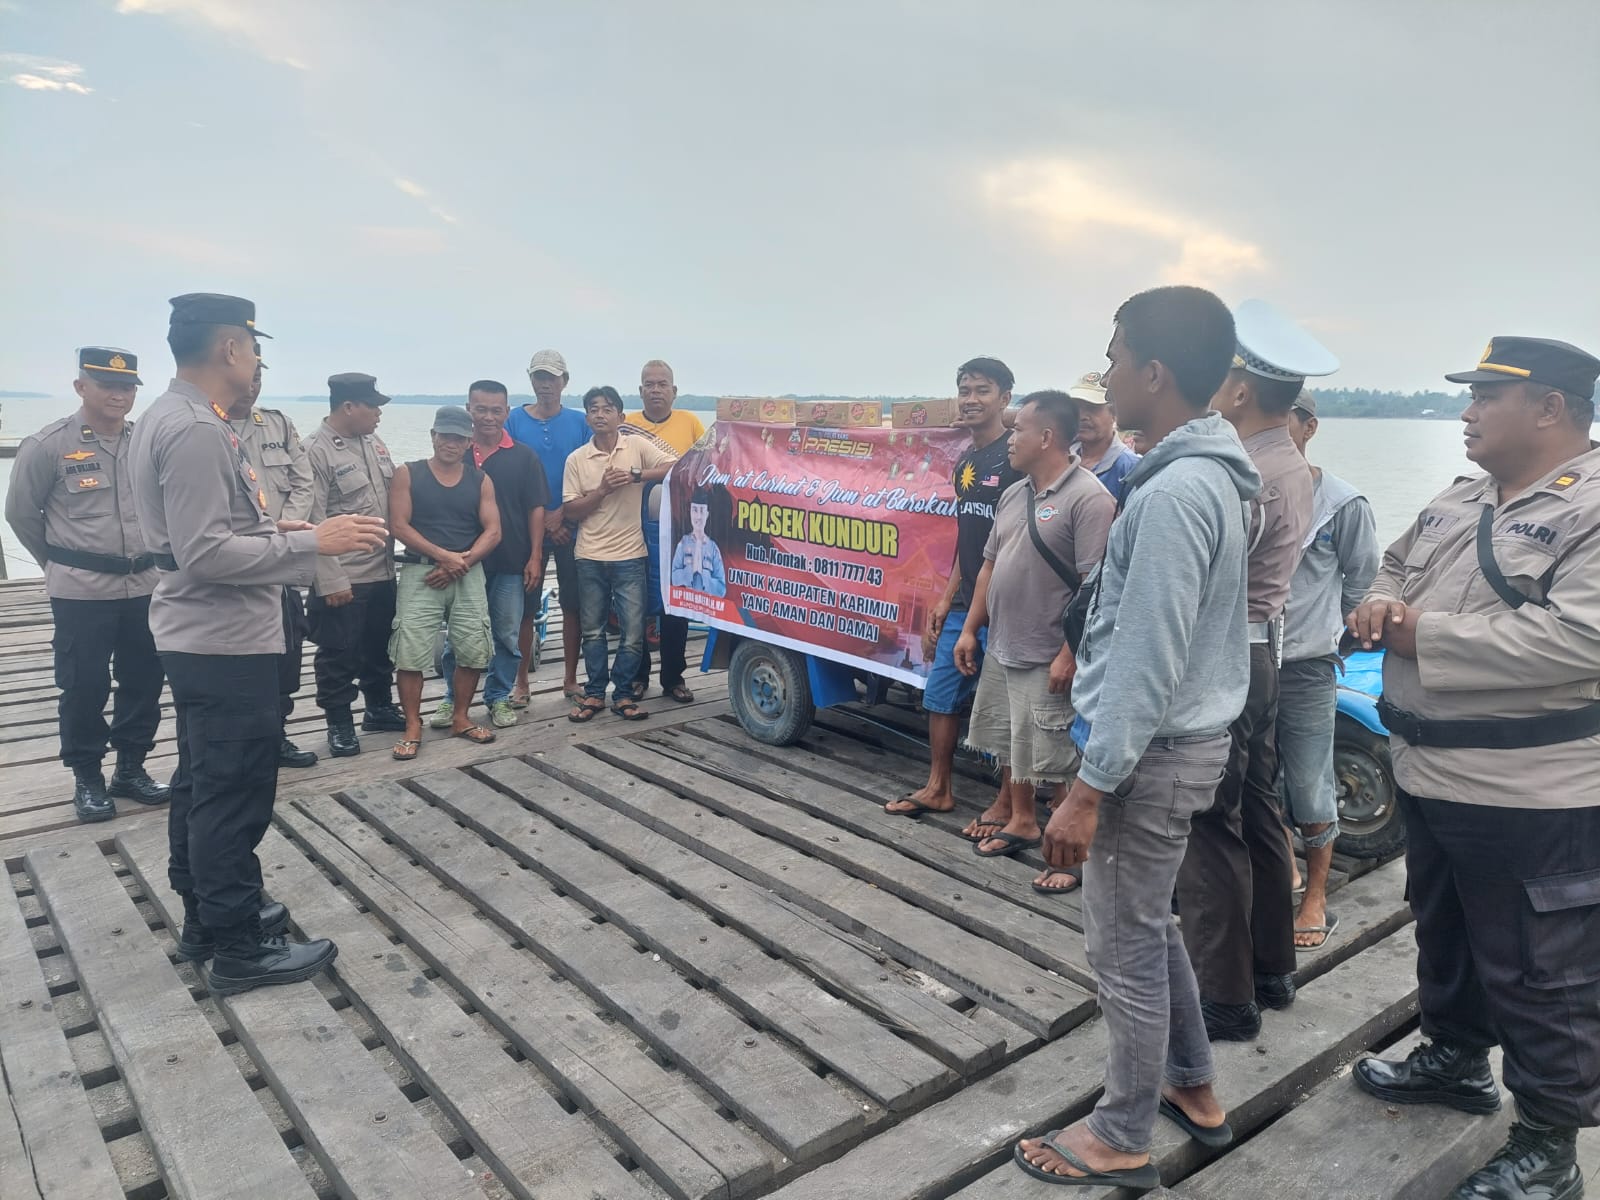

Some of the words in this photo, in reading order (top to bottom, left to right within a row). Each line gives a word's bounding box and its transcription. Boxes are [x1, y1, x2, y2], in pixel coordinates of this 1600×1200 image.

[804, 437, 874, 458] PRESISI
[751, 470, 808, 496] Curhat
[805, 479, 822, 497] &
[737, 500, 807, 539] POLSEK
[807, 510, 899, 558] KUNDUR
[1506, 522, 1557, 545] POLRI
[745, 543, 769, 565] Hub.
[768, 548, 807, 571] Kontak
[813, 557, 840, 578] 0811
[841, 562, 866, 582] 7777
[866, 567, 884, 587] 43
[728, 567, 765, 591] UNTUK
[766, 575, 837, 608] KABUPATEN
[838, 591, 899, 623] KARIMUN
[740, 592, 770, 614] YANG
[771, 600, 807, 624] AMAN
[808, 609, 836, 631] DAN
[837, 616, 880, 643] DAMAI
